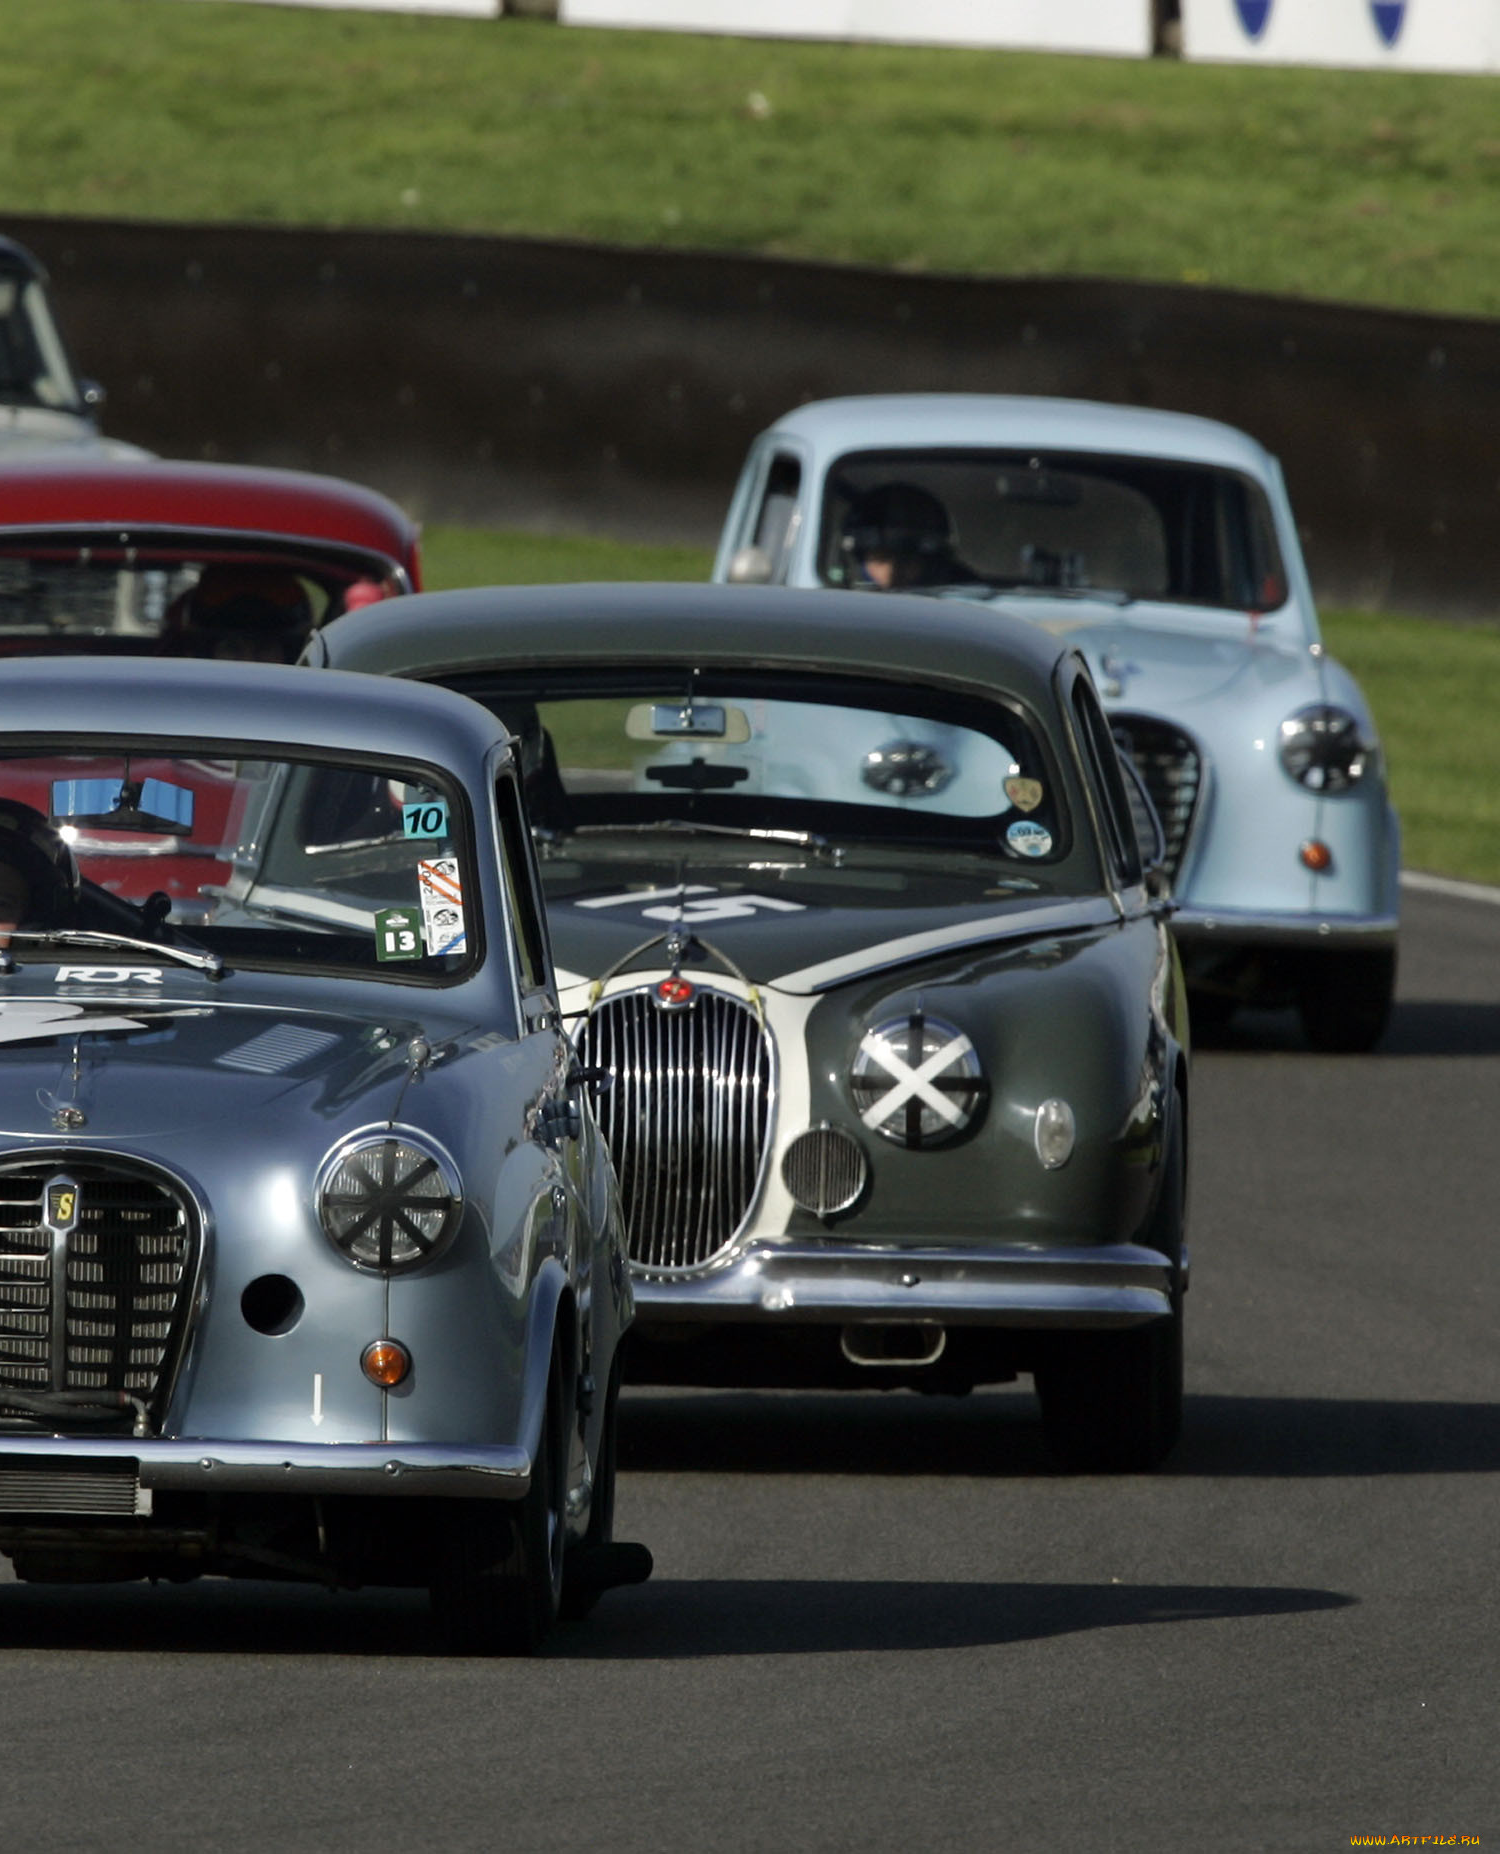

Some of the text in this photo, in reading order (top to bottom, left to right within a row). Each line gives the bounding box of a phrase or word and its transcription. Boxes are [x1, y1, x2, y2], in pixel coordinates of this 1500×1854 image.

[406, 807, 443, 834] 10
[574, 885, 807, 922] 15
[385, 931, 416, 952] 13
[57, 1193, 74, 1220] S
